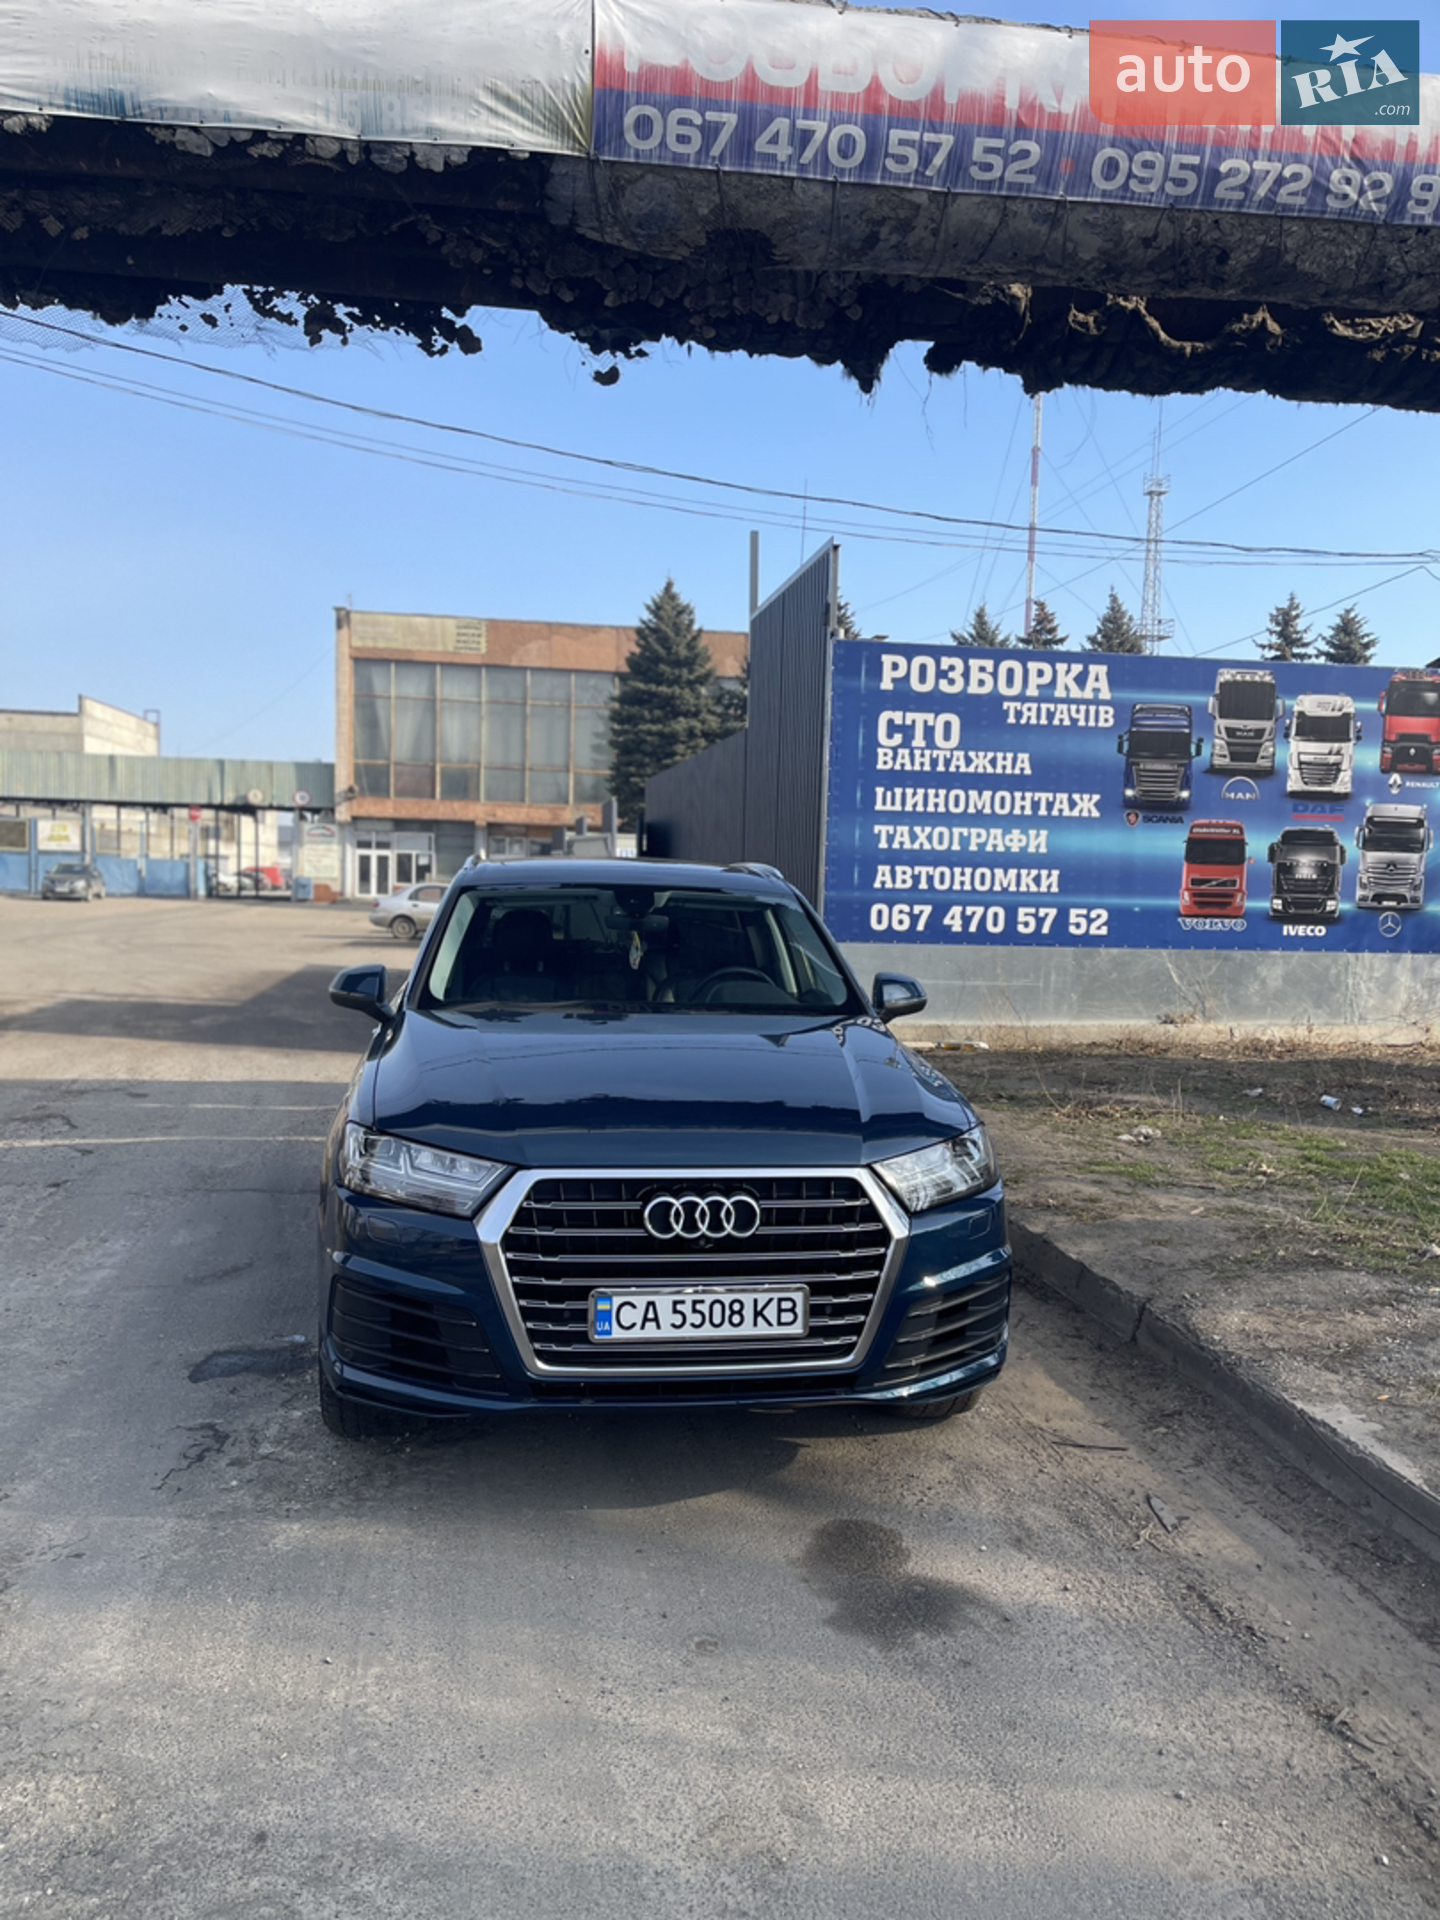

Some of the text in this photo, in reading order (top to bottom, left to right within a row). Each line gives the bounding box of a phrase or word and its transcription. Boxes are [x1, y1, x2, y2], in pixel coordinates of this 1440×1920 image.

[623, 104, 738, 157] 067
[755, 117, 867, 169] 470
[884, 129, 954, 177] 57
[969, 137, 1040, 184] 52
[1091, 147, 1201, 197] 095
[1214, 159, 1312, 205] 272
[1325, 168, 1394, 212] 92
[880, 654, 1111, 700] РОЗБОРКА
[1002, 701, 1115, 727] ТЯГАЧІВ
[877, 710, 961, 749] СТО
[876, 747, 1032, 775] ВАНТАЖНА
[1405, 781, 1440, 789] RENAULT
[874, 786, 1101, 818] ШИНОМОНТАЖ
[1292, 803, 1344, 814] DAF
[1142, 815, 1184, 824] SCANIA
[874, 824, 1048, 853] ТАХОГРАФИ
[873, 864, 1060, 893] АВТОНОМКИ
[870, 903, 1109, 935] 067 470 57 52
[1178, 917, 1247, 931] VOLVO
[1282, 925, 1327, 937] IVECO
[596, 1321, 611, 1331] UA
[615, 1297, 798, 1331] CA 5508 KB
